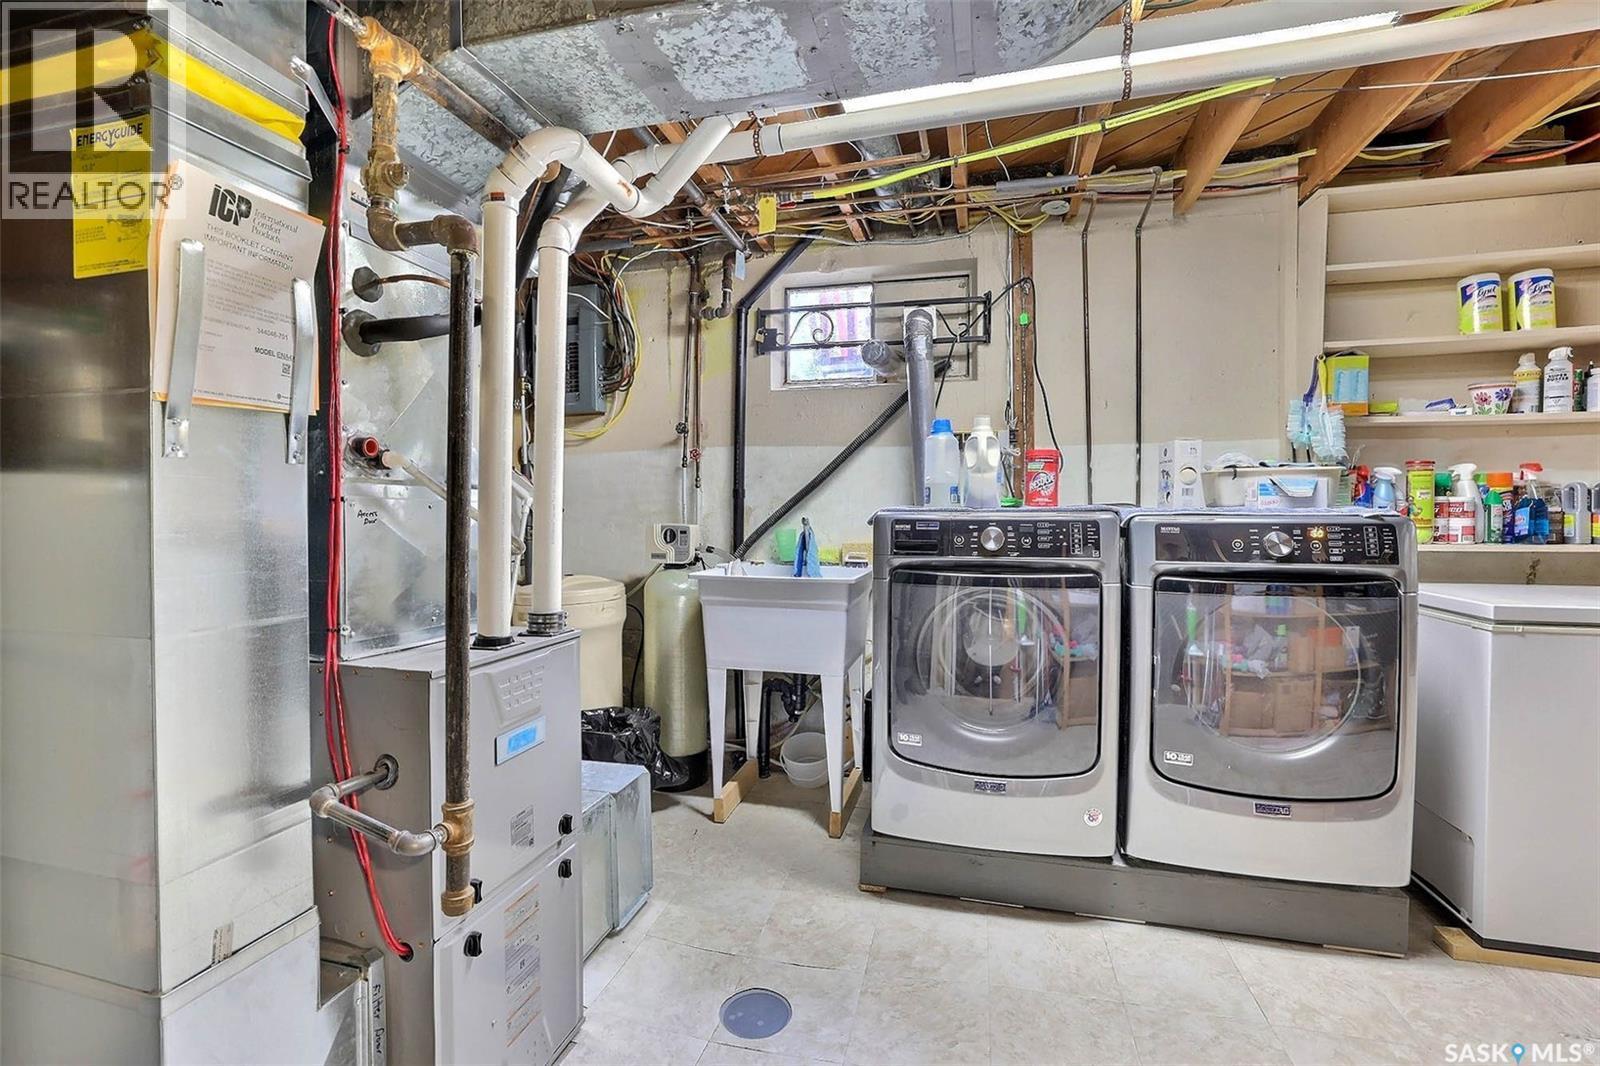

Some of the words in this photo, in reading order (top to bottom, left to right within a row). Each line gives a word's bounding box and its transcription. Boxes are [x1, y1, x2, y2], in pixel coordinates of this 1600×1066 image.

[252, 217, 281, 235] Comfort
[254, 208, 299, 233] International
[207, 223, 224, 236] THIS
[225, 230, 259, 248] BOOKLET
[260, 245, 294, 262] CONTAINS
[251, 225, 281, 244] Products
[204, 233, 247, 255] IMPORTANT
[247, 250, 293, 271] INFORMATION
[254, 346, 276, 358] MODEL
